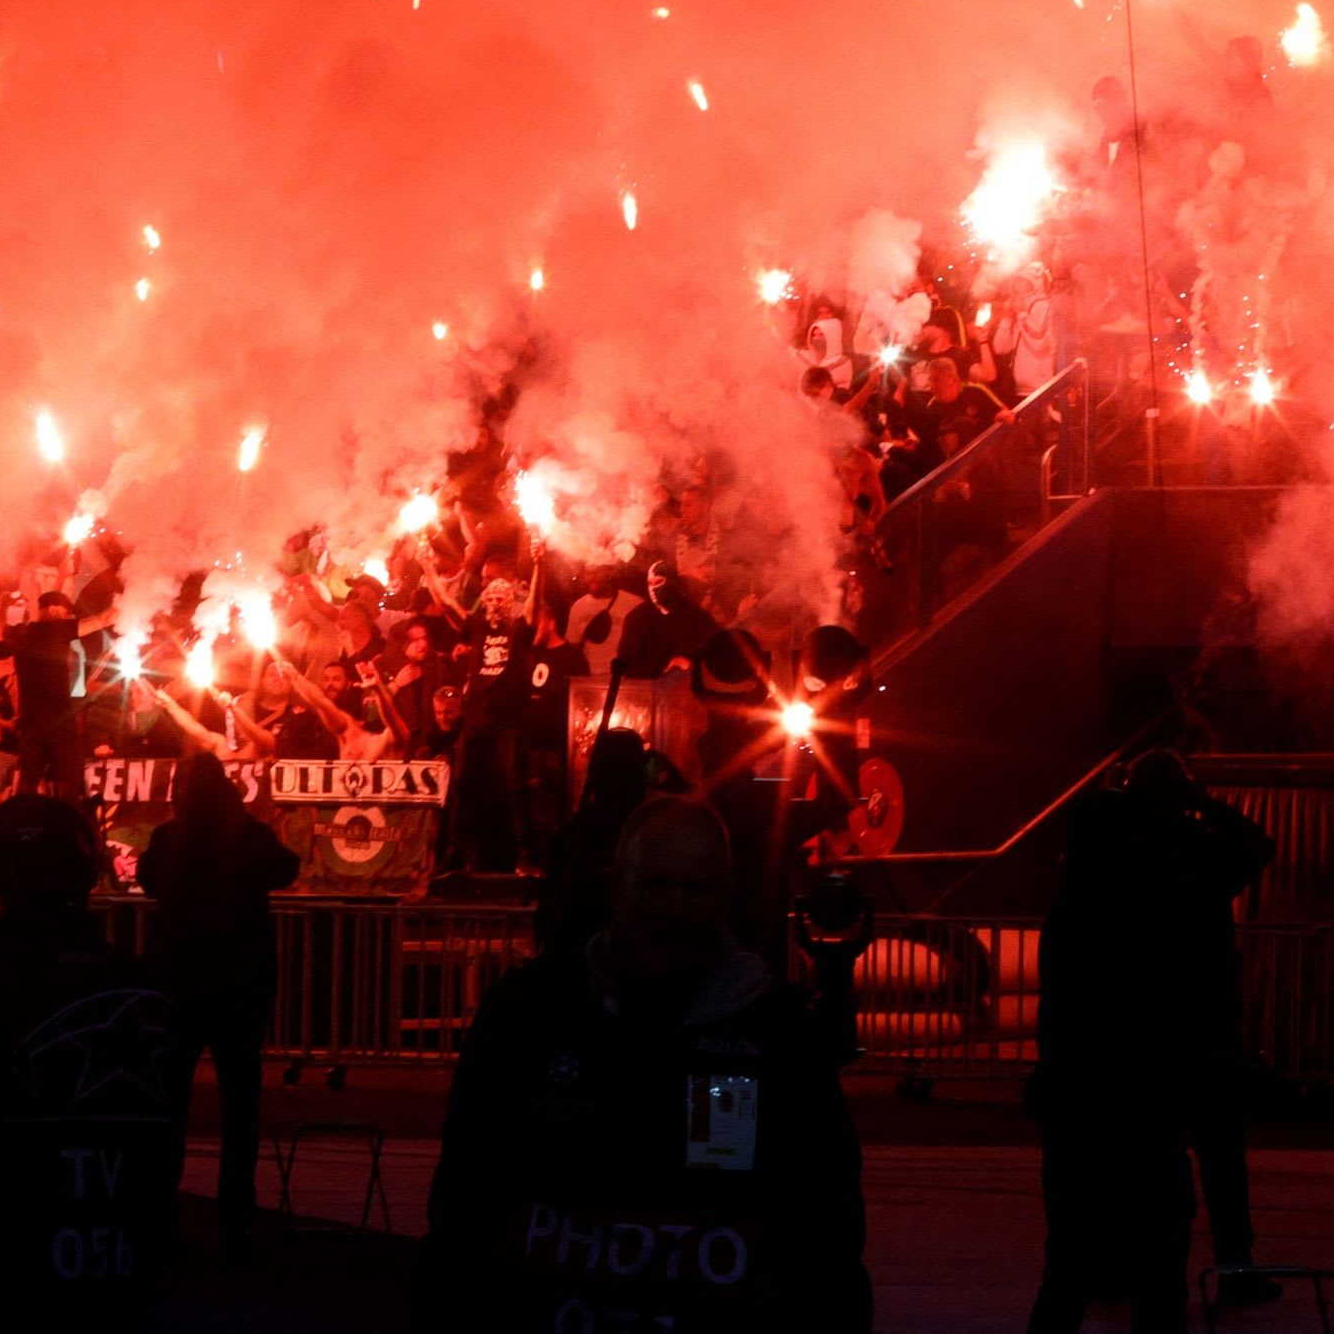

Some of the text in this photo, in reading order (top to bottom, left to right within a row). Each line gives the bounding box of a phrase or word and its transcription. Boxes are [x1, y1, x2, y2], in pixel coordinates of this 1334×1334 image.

[58, 1145, 125, 1202] TV
[49, 1225, 137, 1281] 056
[522, 1201, 750, 1287] PHOTO
